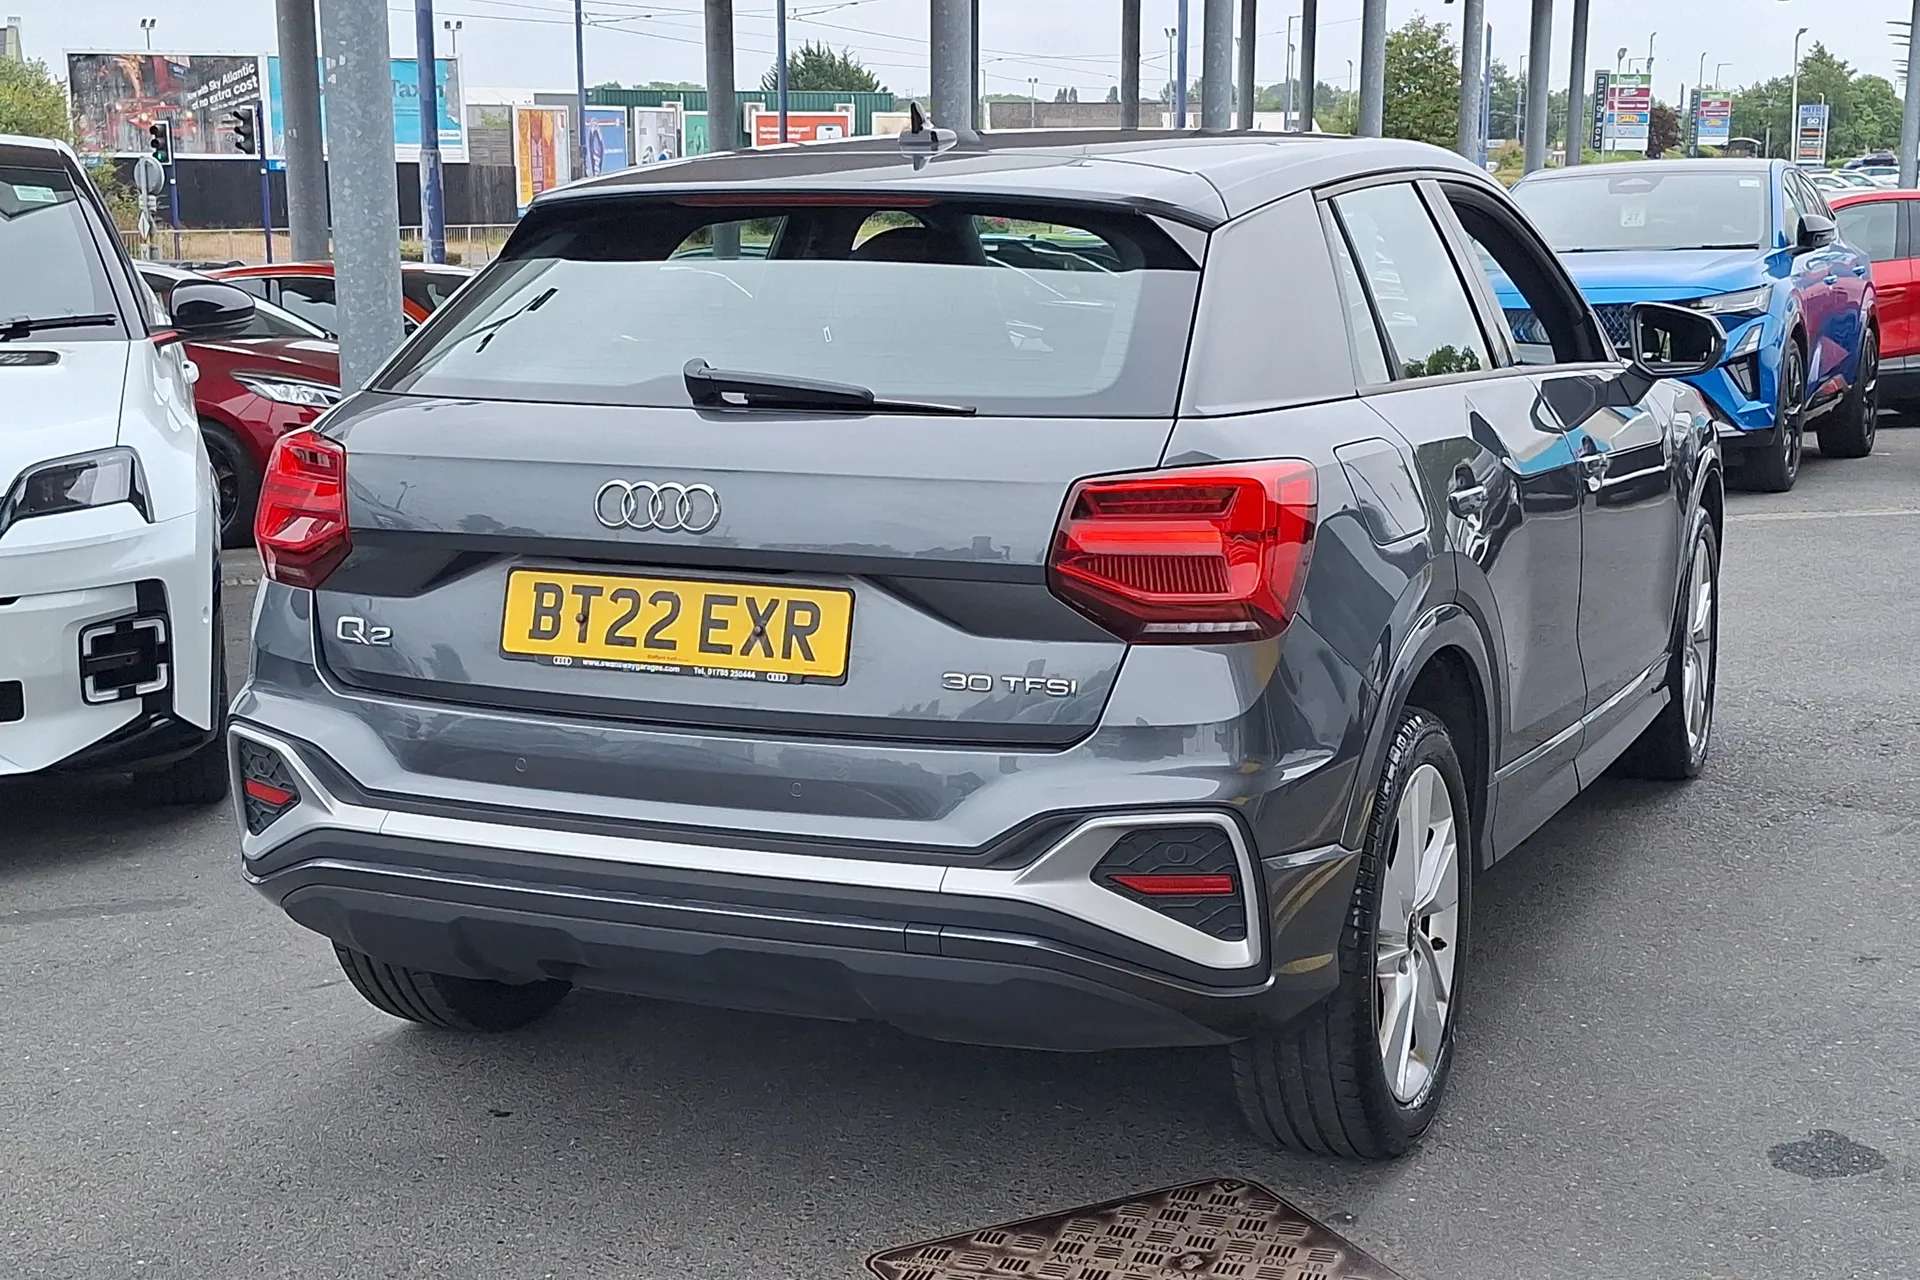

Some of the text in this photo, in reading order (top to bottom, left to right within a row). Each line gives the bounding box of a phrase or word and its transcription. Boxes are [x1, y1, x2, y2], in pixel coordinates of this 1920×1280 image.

[222, 62, 256, 86] Atlantic
[209, 88, 232, 104] extra
[233, 75, 258, 95] cost
[1594, 121, 1603, 148] ROAD
[336, 615, 391, 646] Q2
[528, 581, 822, 662] BT22 EXR
[942, 672, 1077, 697] 30 TFSI
[1120, 1217, 1298, 1244] PETER SAVAGE
[1131, 1241, 1183, 1255] D400
